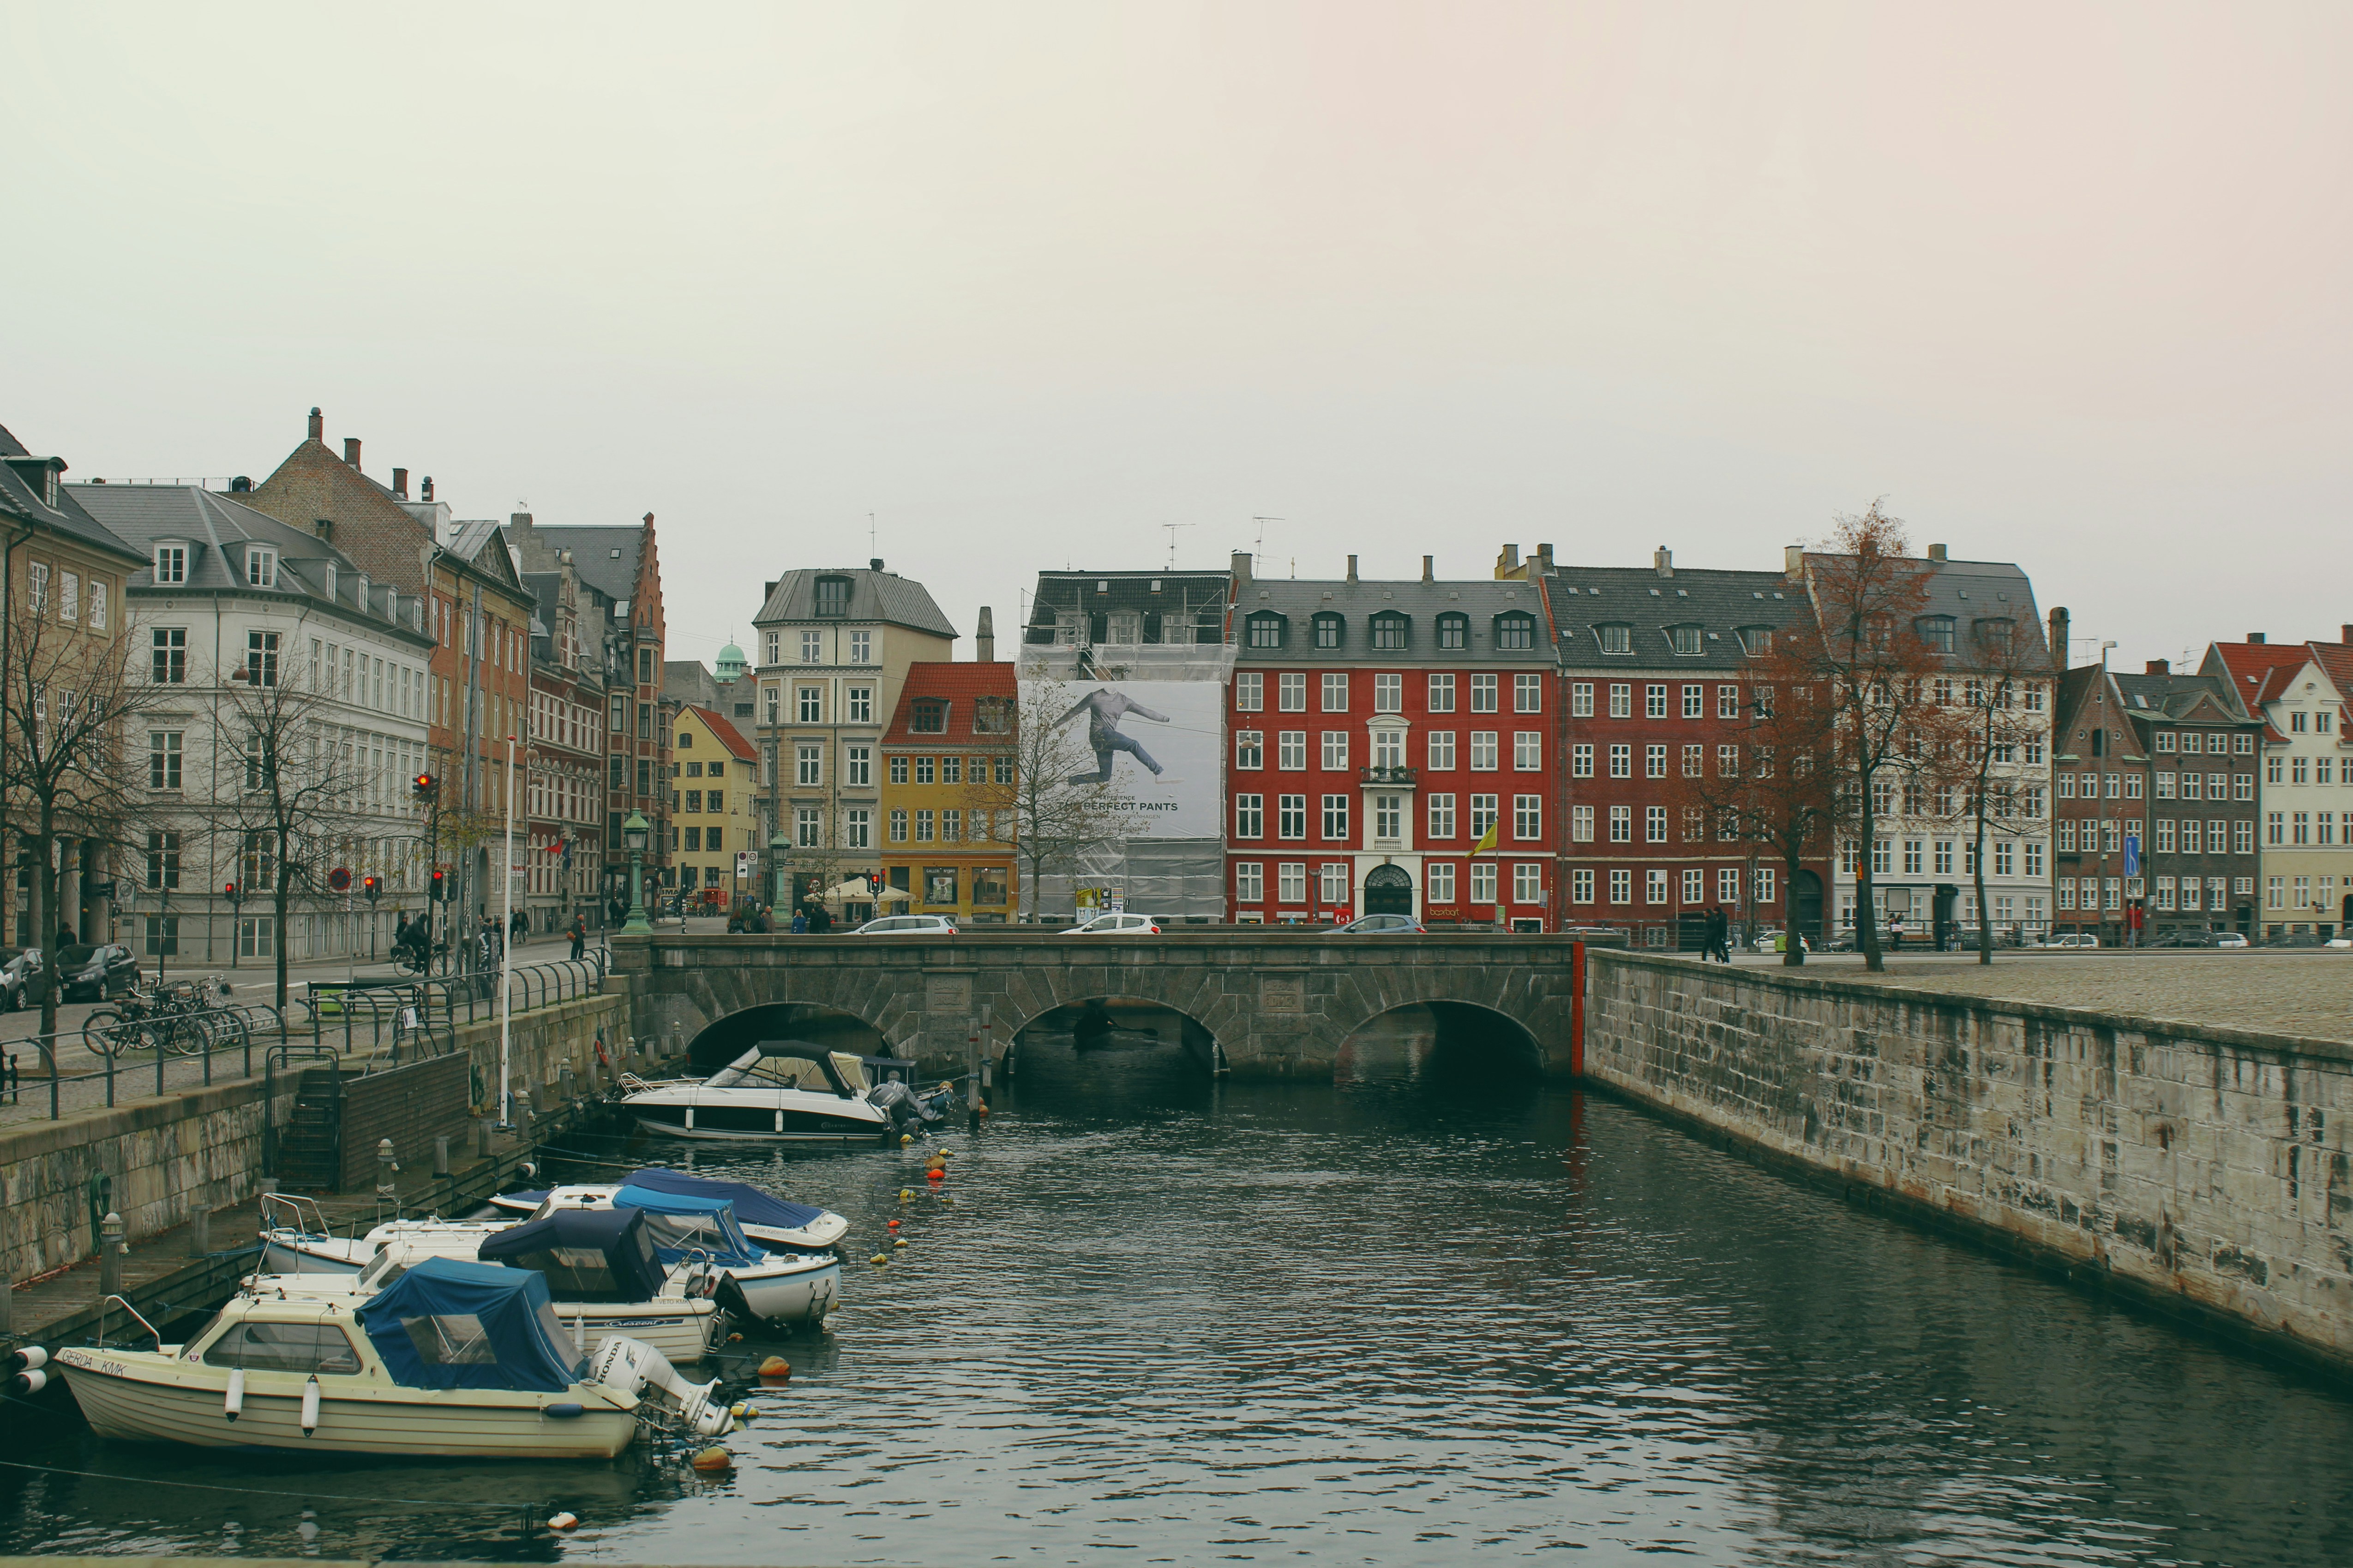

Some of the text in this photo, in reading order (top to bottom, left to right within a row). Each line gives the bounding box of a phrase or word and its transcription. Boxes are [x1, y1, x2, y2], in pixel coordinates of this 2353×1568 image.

[62, 1350, 127, 1376] GERDA KMK
[598, 1341, 622, 1384] HONDA
